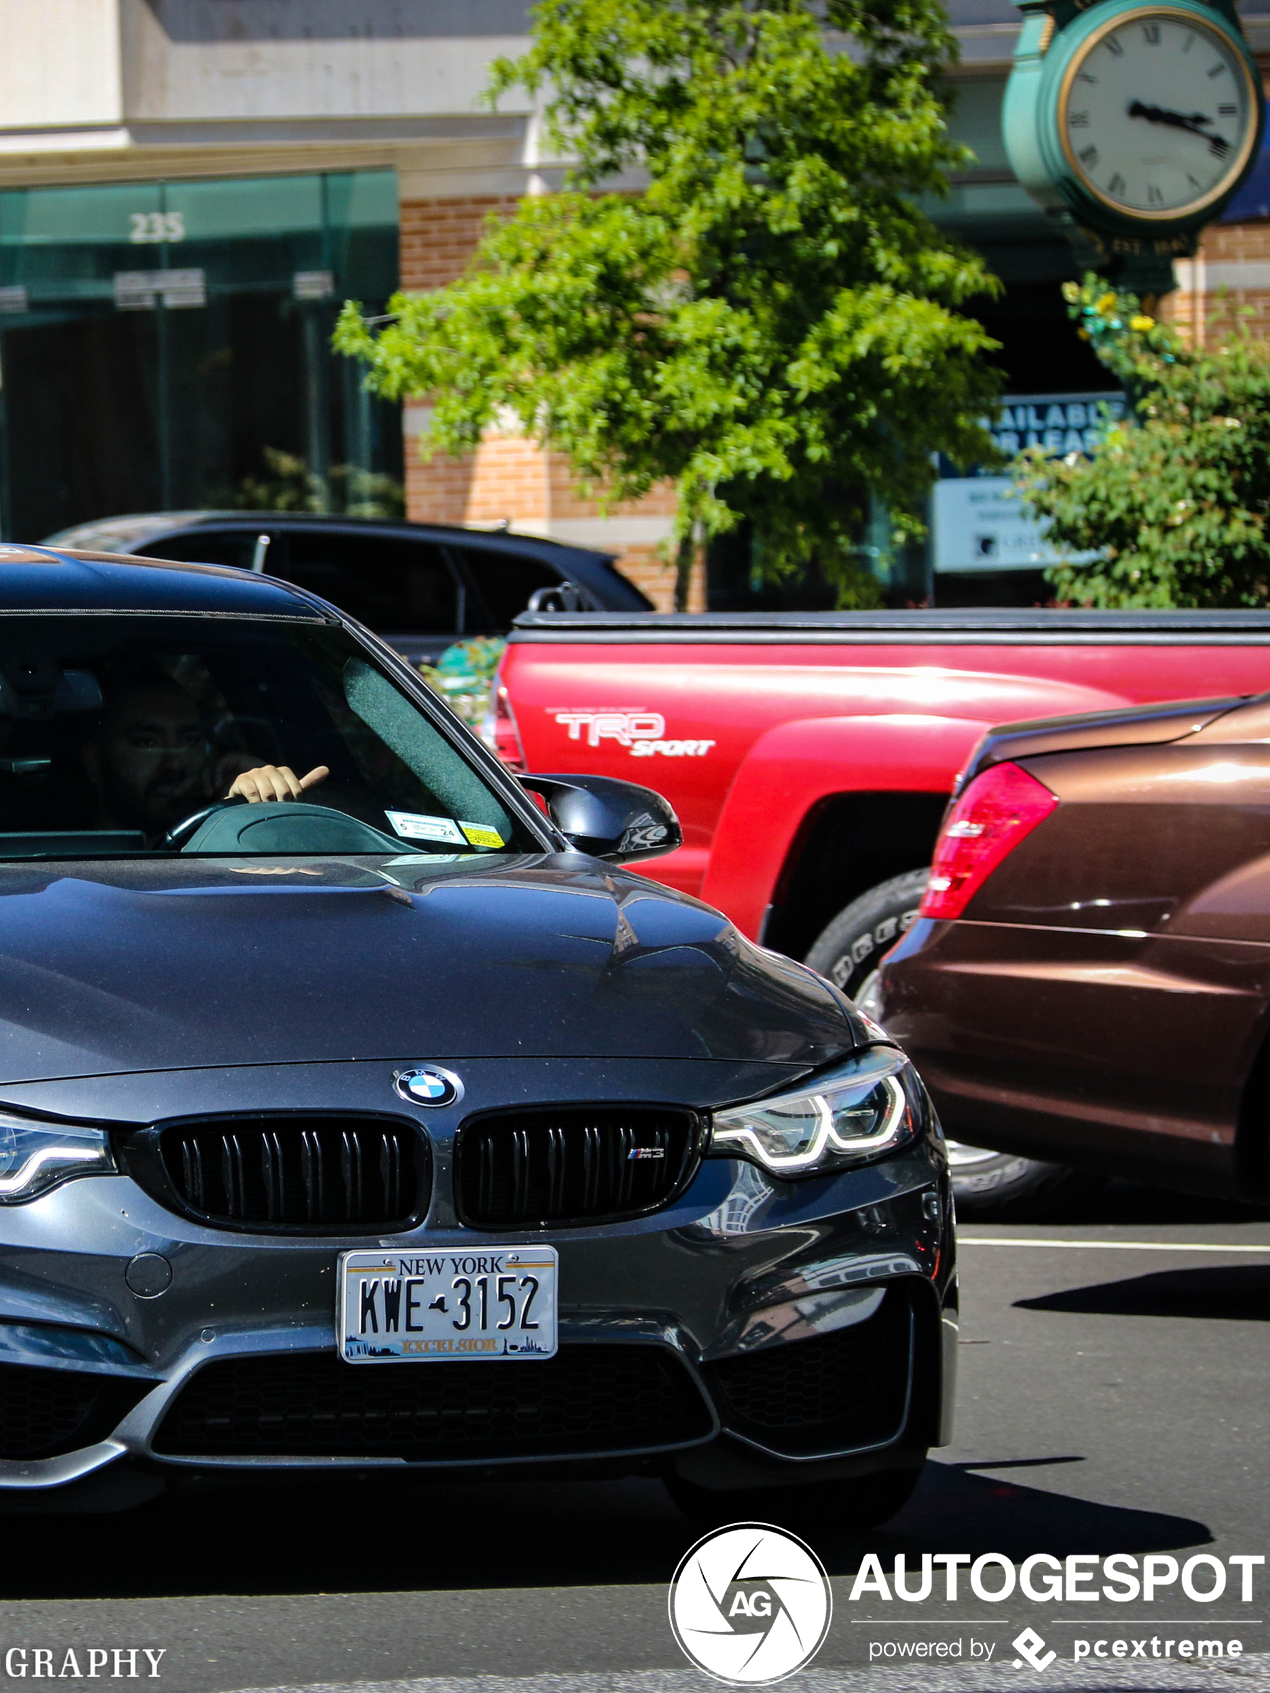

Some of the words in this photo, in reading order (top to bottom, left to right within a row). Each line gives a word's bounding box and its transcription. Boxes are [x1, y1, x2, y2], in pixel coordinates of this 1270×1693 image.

[130, 212, 185, 244] 235
[555, 713, 665, 746] TRD
[630, 740, 716, 757] SPORT
[400, 1069, 446, 1081] BMW
[638, 1148, 664, 1158] M3
[399, 1259, 445, 1276] NEW
[450, 1256, 504, 1275] YORK
[359, 1277, 425, 1334] KWE
[451, 1274, 539, 1331] 3152
[401, 1338, 498, 1354] EXCELSIOR
